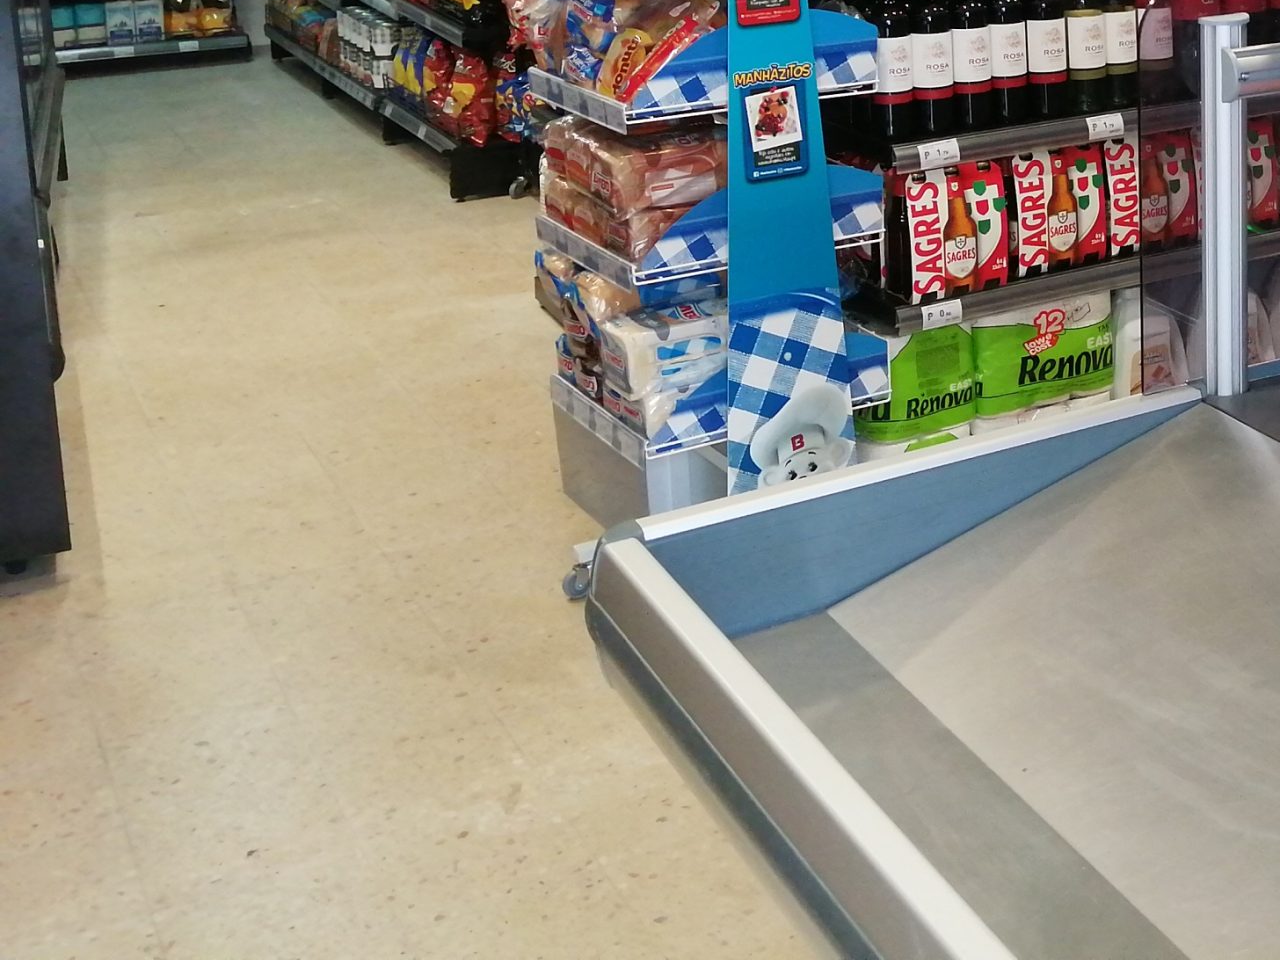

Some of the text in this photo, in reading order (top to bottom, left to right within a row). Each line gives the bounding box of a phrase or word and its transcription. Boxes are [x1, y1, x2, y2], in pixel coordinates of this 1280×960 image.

[926, 63, 949, 71] ROSA
[1103, 143, 1140, 247] SAGRES
[1012, 159, 1049, 267] SAGRES
[906, 181, 946, 296] SAGRES
[1050, 223, 1077, 238] SAGRES
[947, 247, 976, 264] SAGRES
[1034, 308, 1066, 335] 12
[1018, 344, 1113, 385] Renova
[906, 385, 973, 419] Renova
